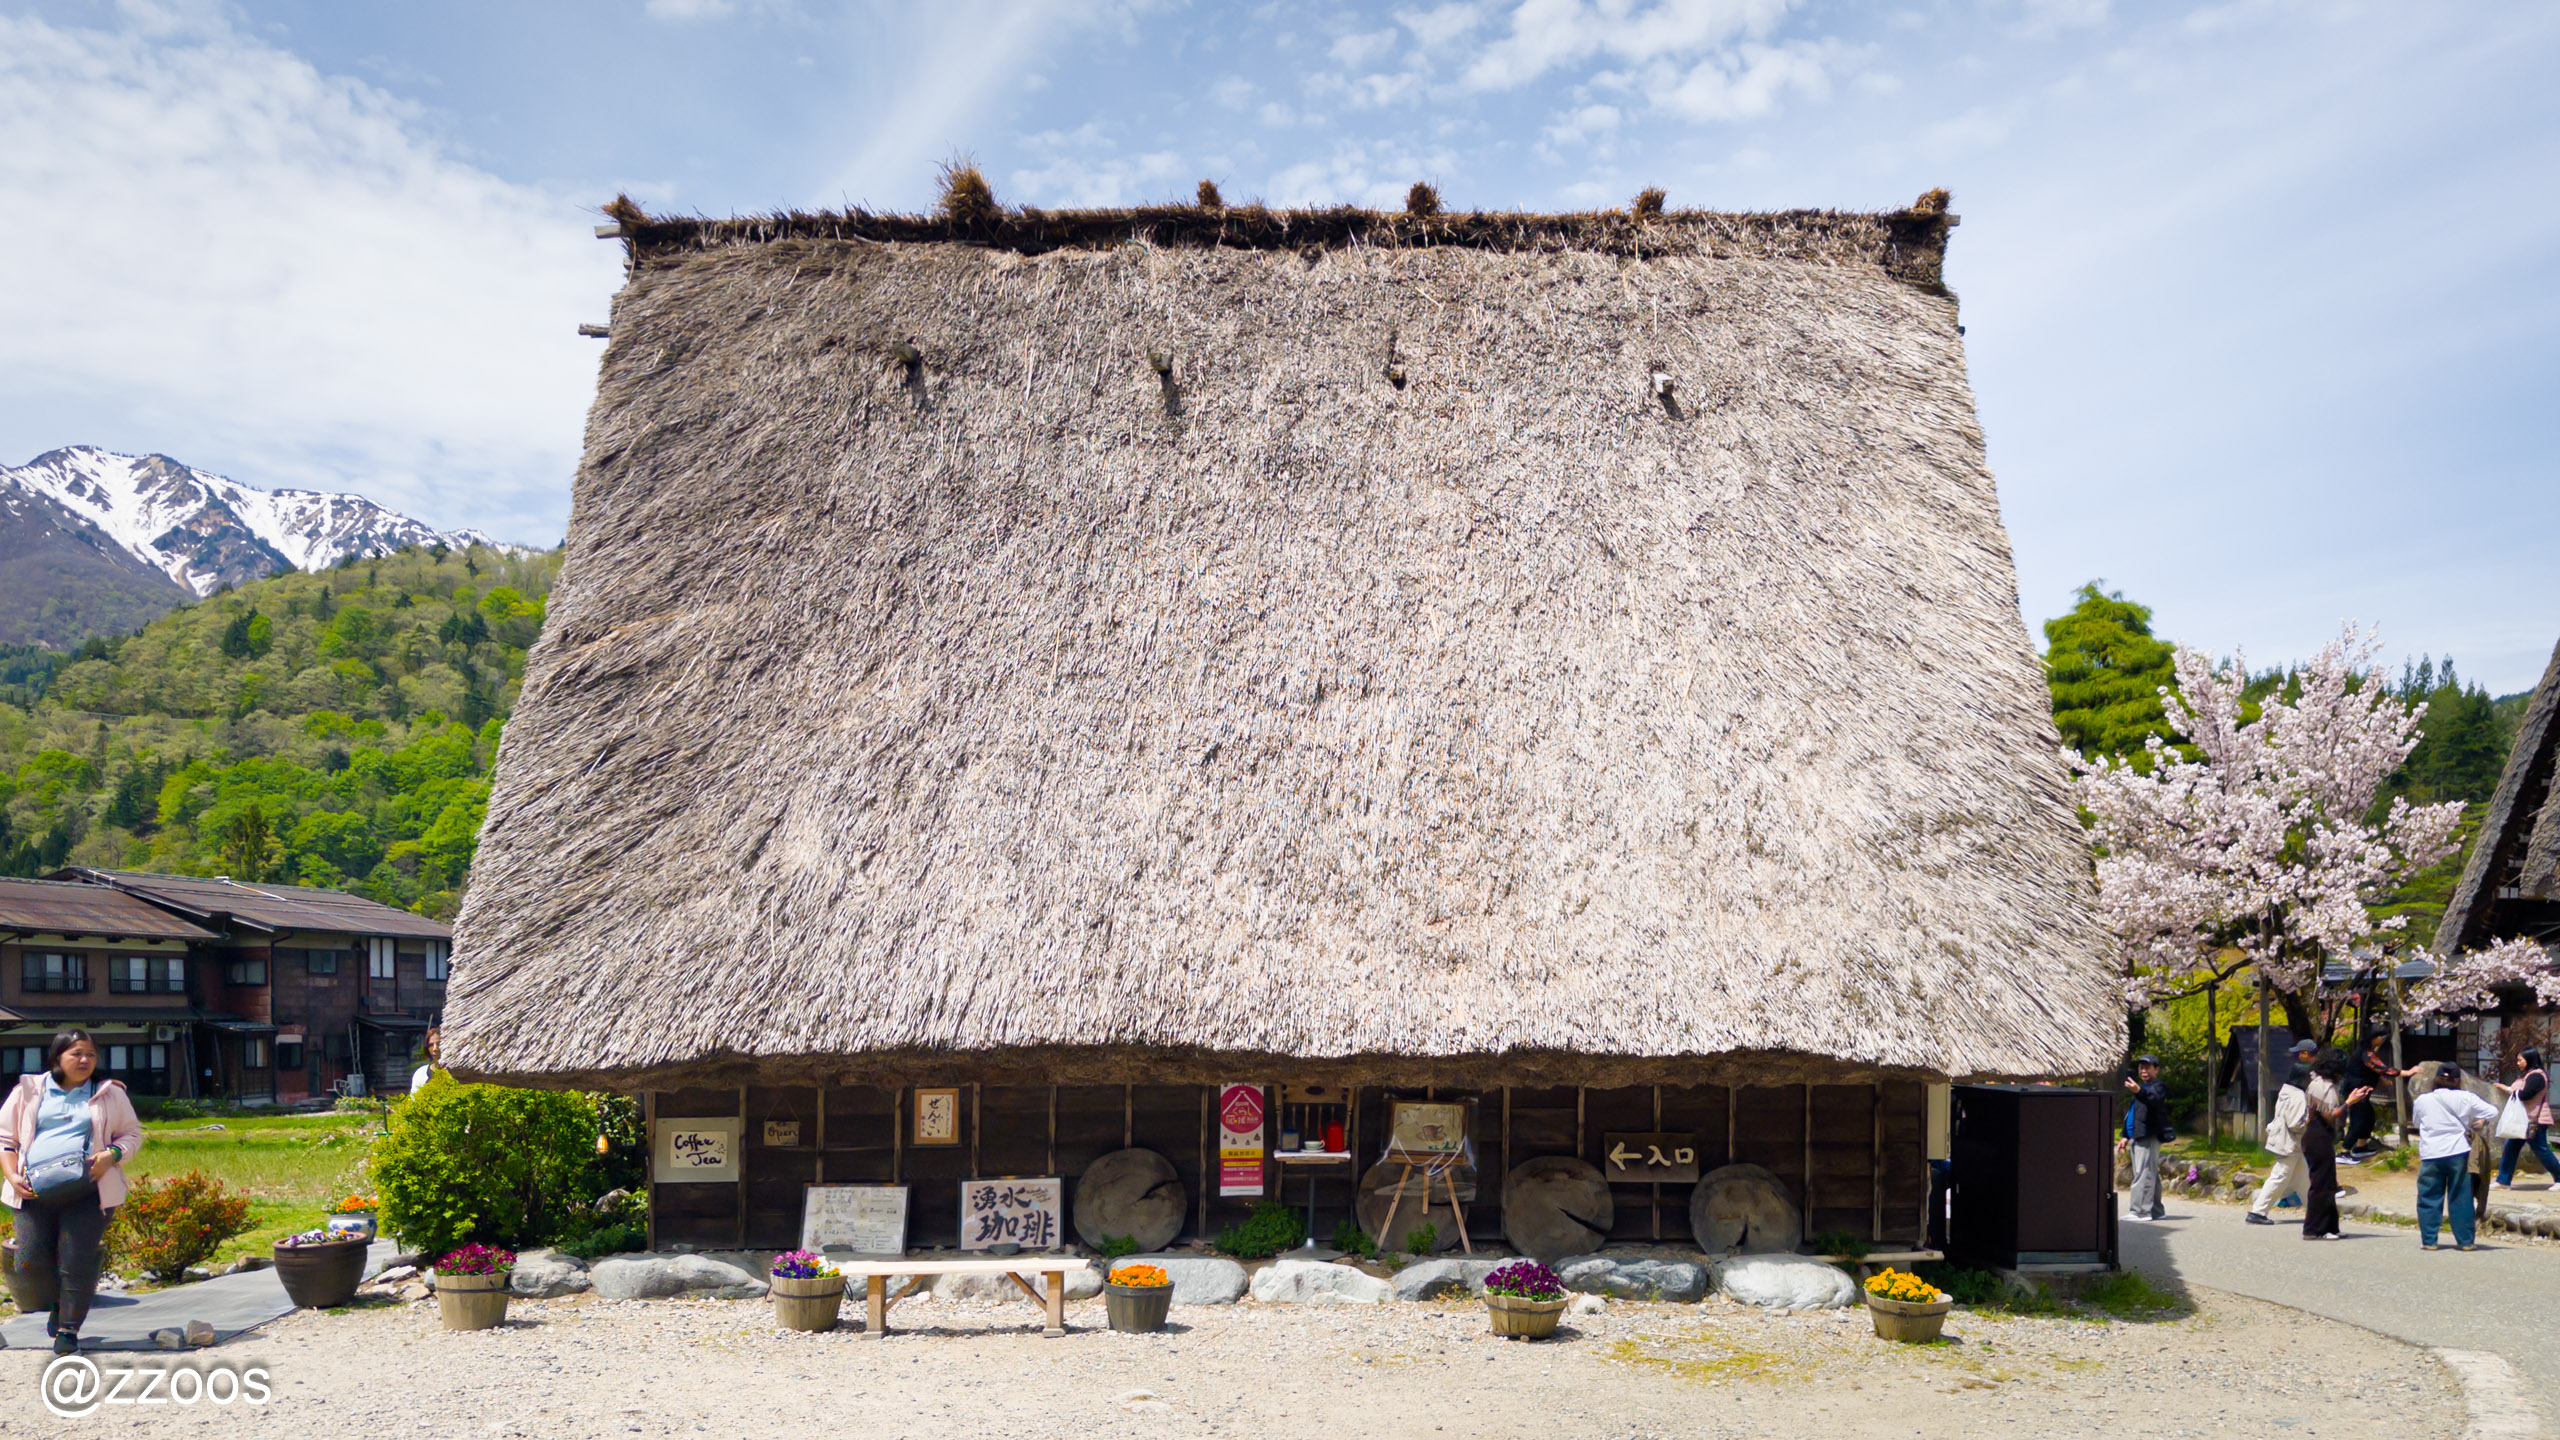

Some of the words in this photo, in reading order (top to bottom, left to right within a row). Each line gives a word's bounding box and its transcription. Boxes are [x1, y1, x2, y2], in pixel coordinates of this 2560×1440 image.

[674, 1133, 716, 1152] Coffee
[768, 1126, 799, 1142] Open
[686, 1150, 722, 1167] Tea
[1647, 1145, 1694, 1167] 入口
[972, 1185, 1032, 1211] 湧水
[976, 1210, 1055, 1246] 珈琲
